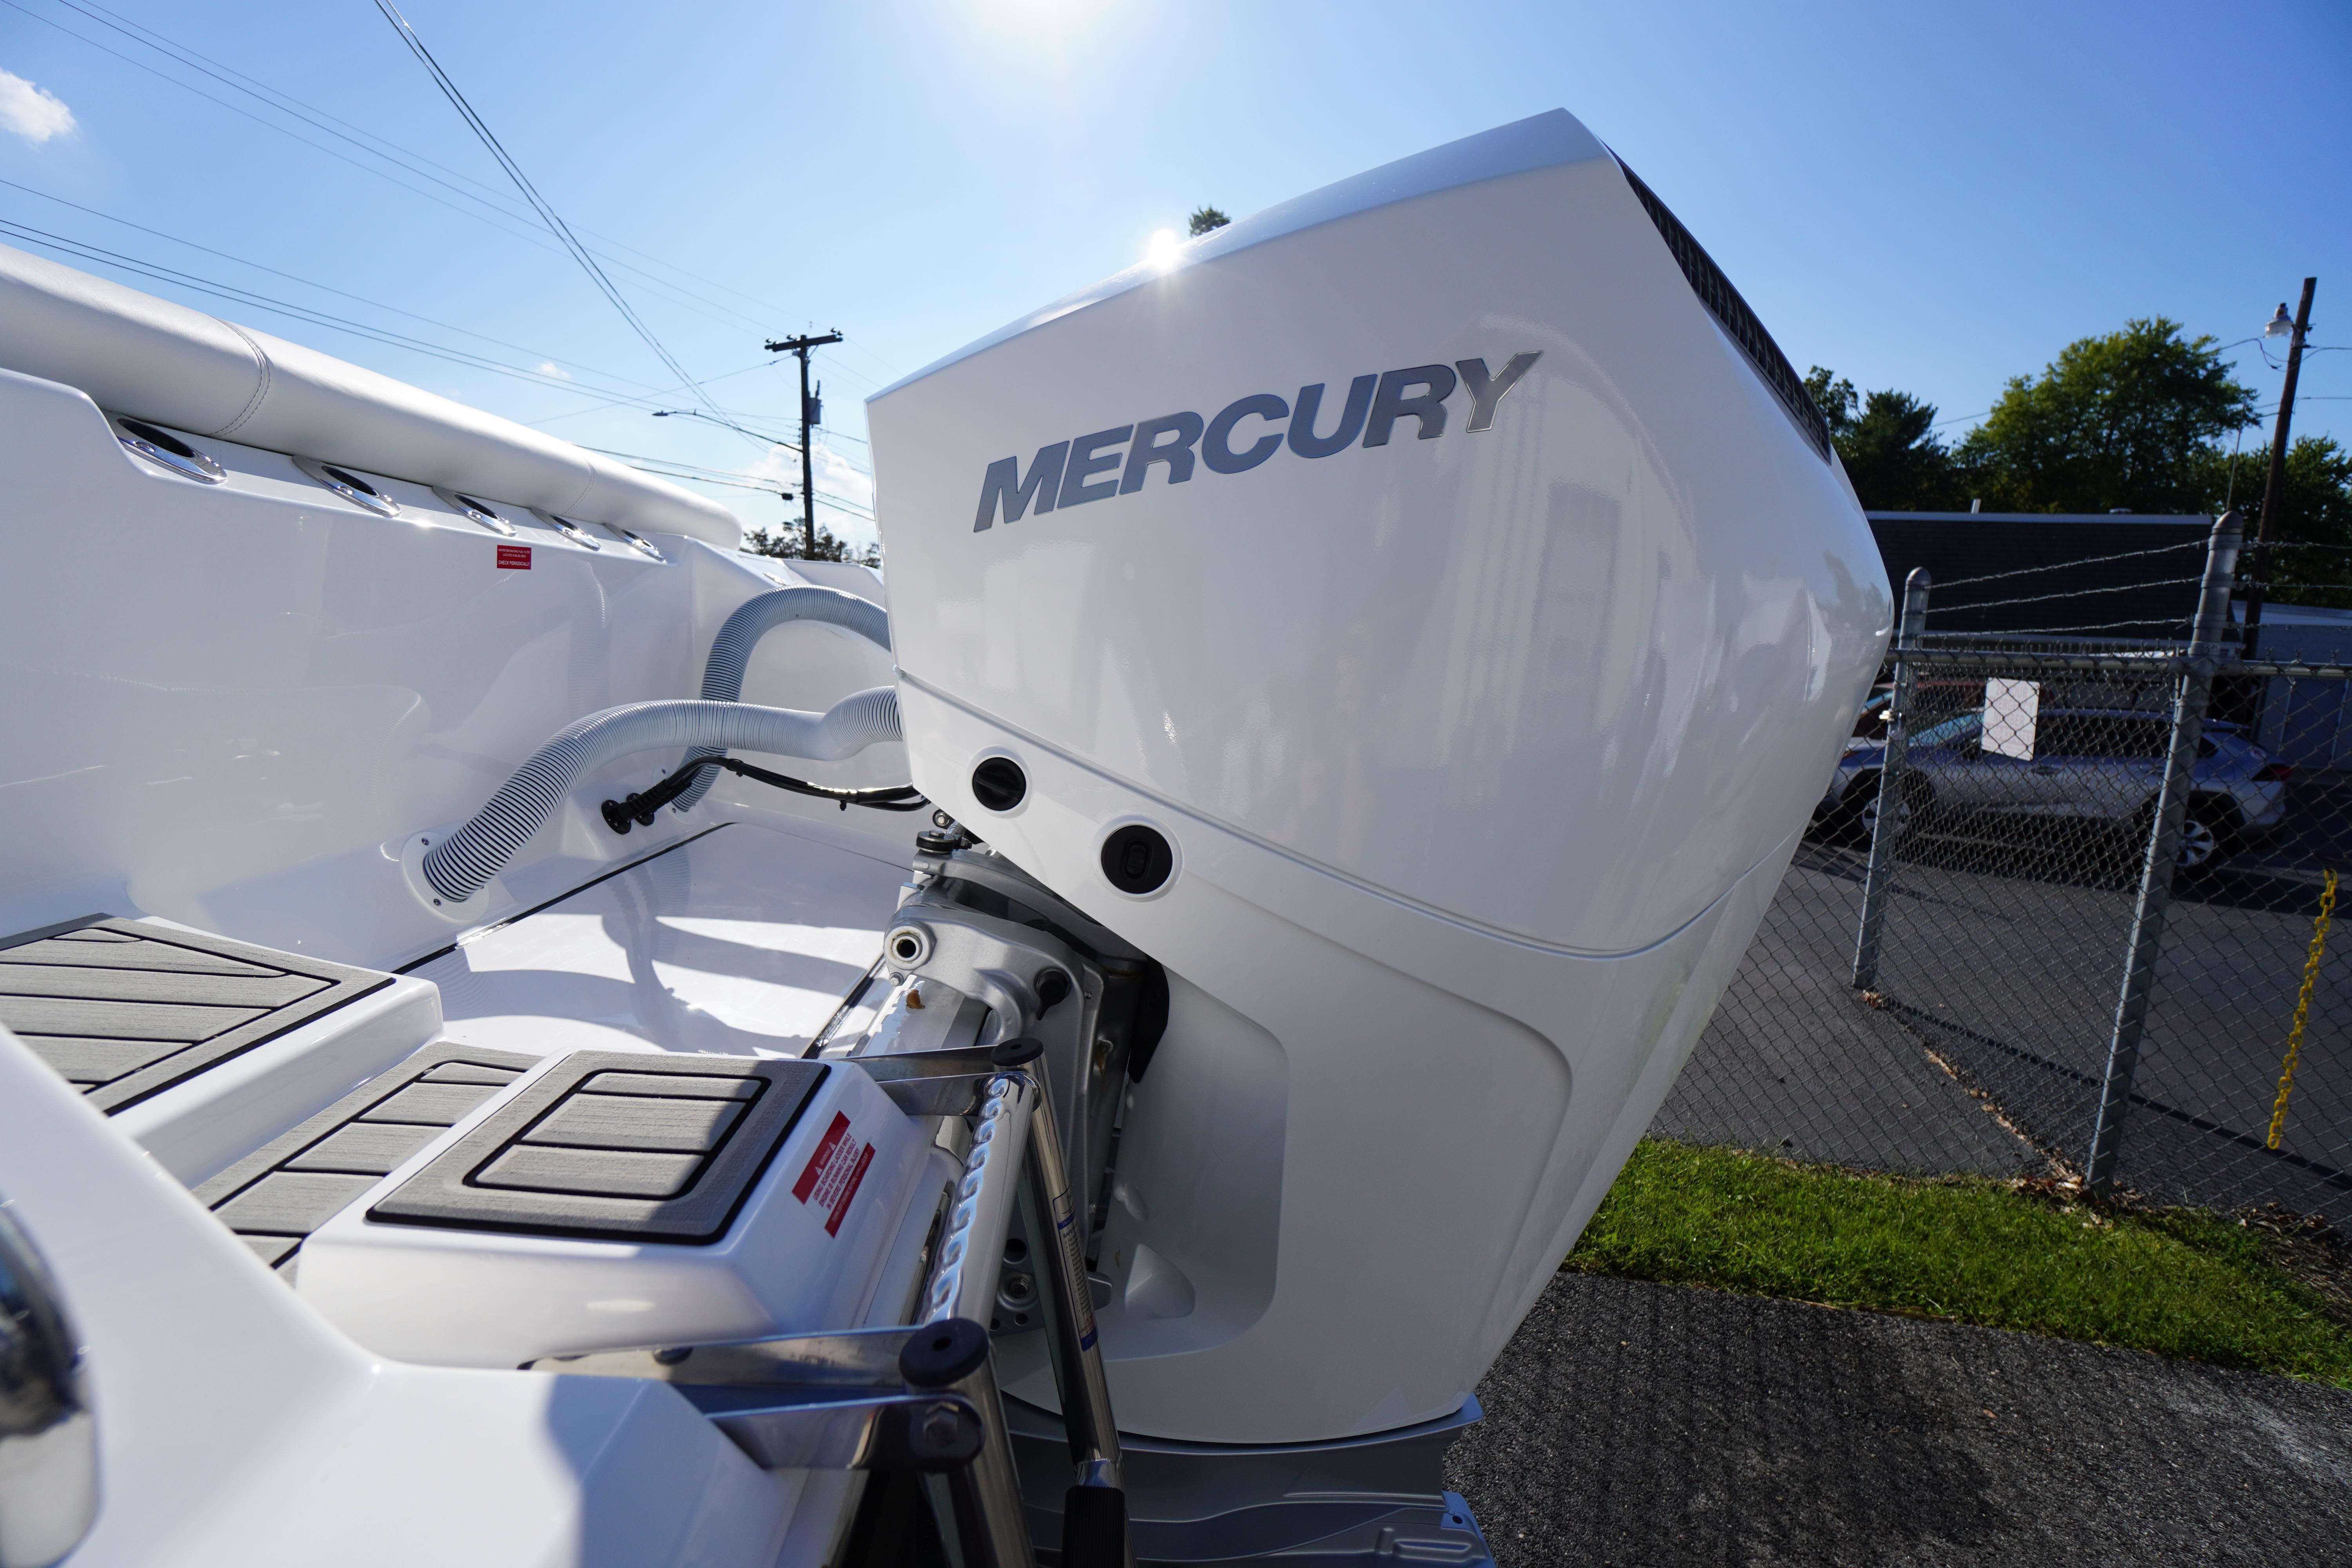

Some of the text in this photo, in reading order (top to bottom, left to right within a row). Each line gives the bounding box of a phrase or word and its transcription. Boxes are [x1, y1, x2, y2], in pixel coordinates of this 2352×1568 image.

[973, 350, 1544, 533] MERCURY
[813, 1132, 851, 1201] USING BOARDING LADDER WHILE
[819, 1187, 831, 1207] ENGINE
[831, 1163, 843, 1184] RUNNING
[846, 1139, 857, 1156] RESULT
[830, 1184, 841, 1204] SEVERE
[839, 1162, 853, 1186] PERSONAL
[851, 1147, 860, 1163] INJURY
